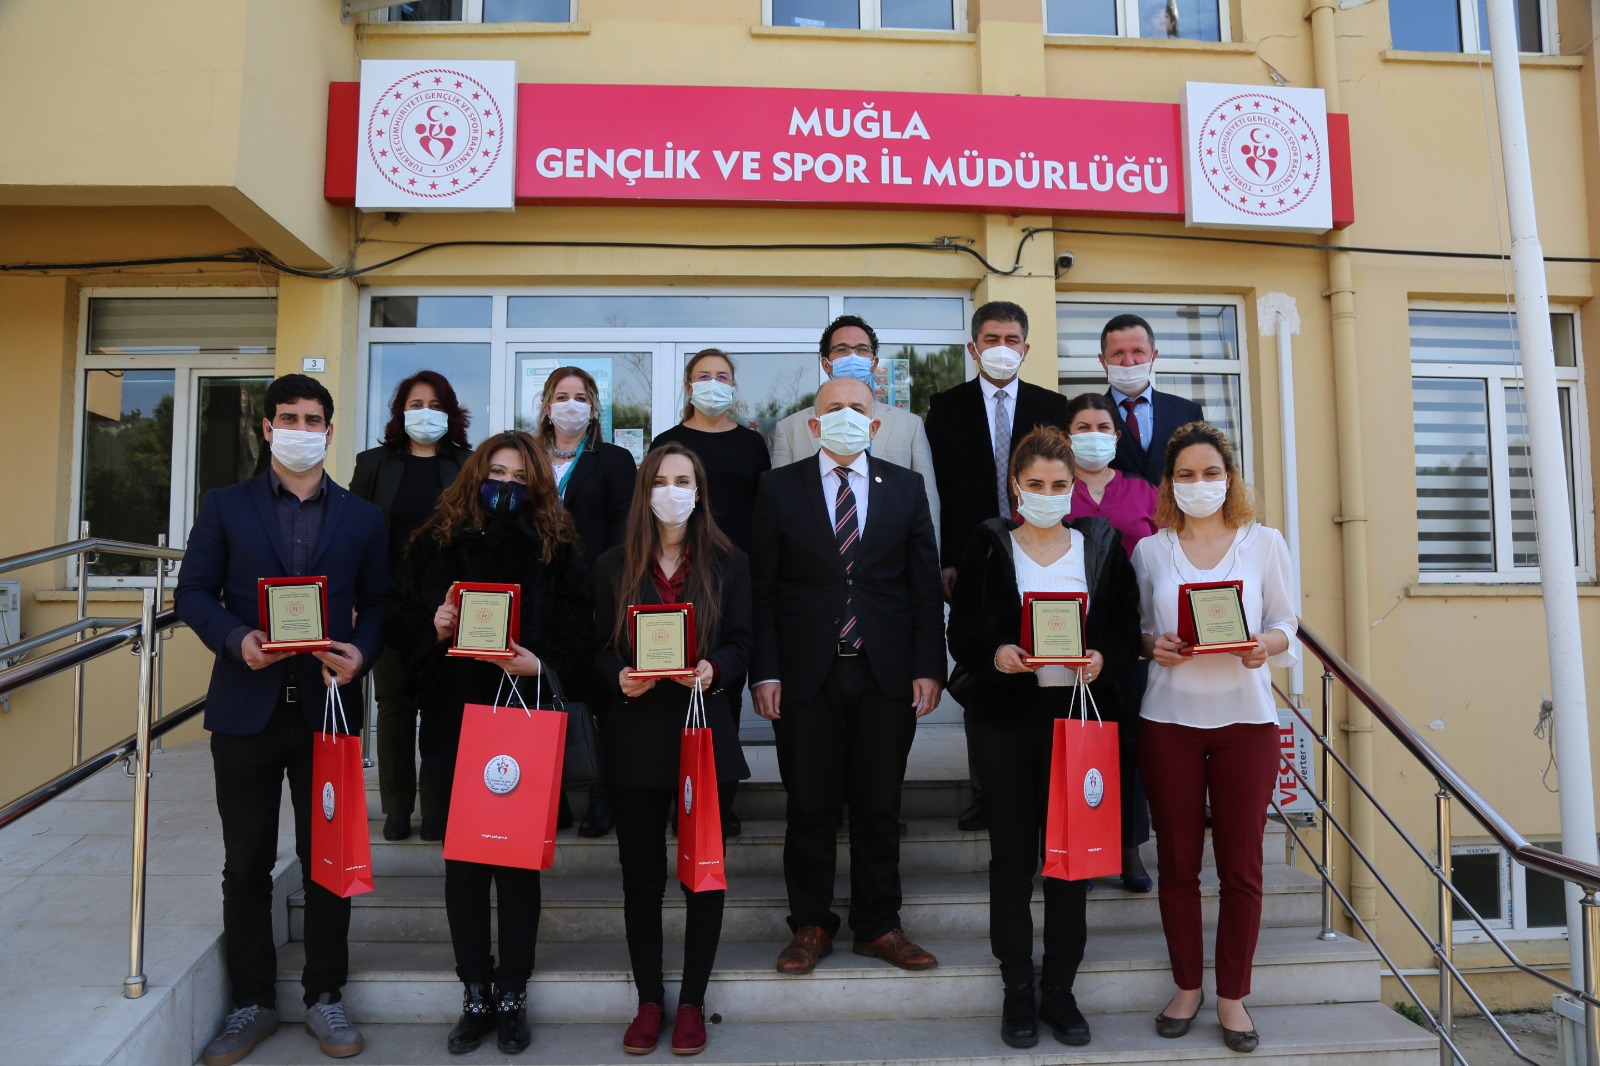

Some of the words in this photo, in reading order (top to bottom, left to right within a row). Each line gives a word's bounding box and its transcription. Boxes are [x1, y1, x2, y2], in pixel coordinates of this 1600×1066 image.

[425, 92, 461, 105] GENÇLİK
[462, 102, 470, 112] VE
[393, 94, 424, 145] CUMHURİYETİ
[468, 112, 479, 134] SPOR
[788, 102, 931, 140] MUĞLA
[1247, 116, 1279, 128] GENÇLİK
[1280, 126, 1289, 136] VE
[1222, 116, 1246, 164] CUMHURİYETİ
[1288, 136, 1298, 156] SPOR
[396, 146, 424, 172] TÜRKİYE
[446, 136, 479, 172] BAKANLIĞI
[535, 142, 701, 186] GENÇLİK
[714, 151, 761, 181] VE
[772, 153, 870, 184] SPOR
[880, 148, 912, 185] İL
[923, 150, 1169, 195] MÜDÜRLÜĞÜ
[1224, 166, 1252, 192] TÜRKİYE
